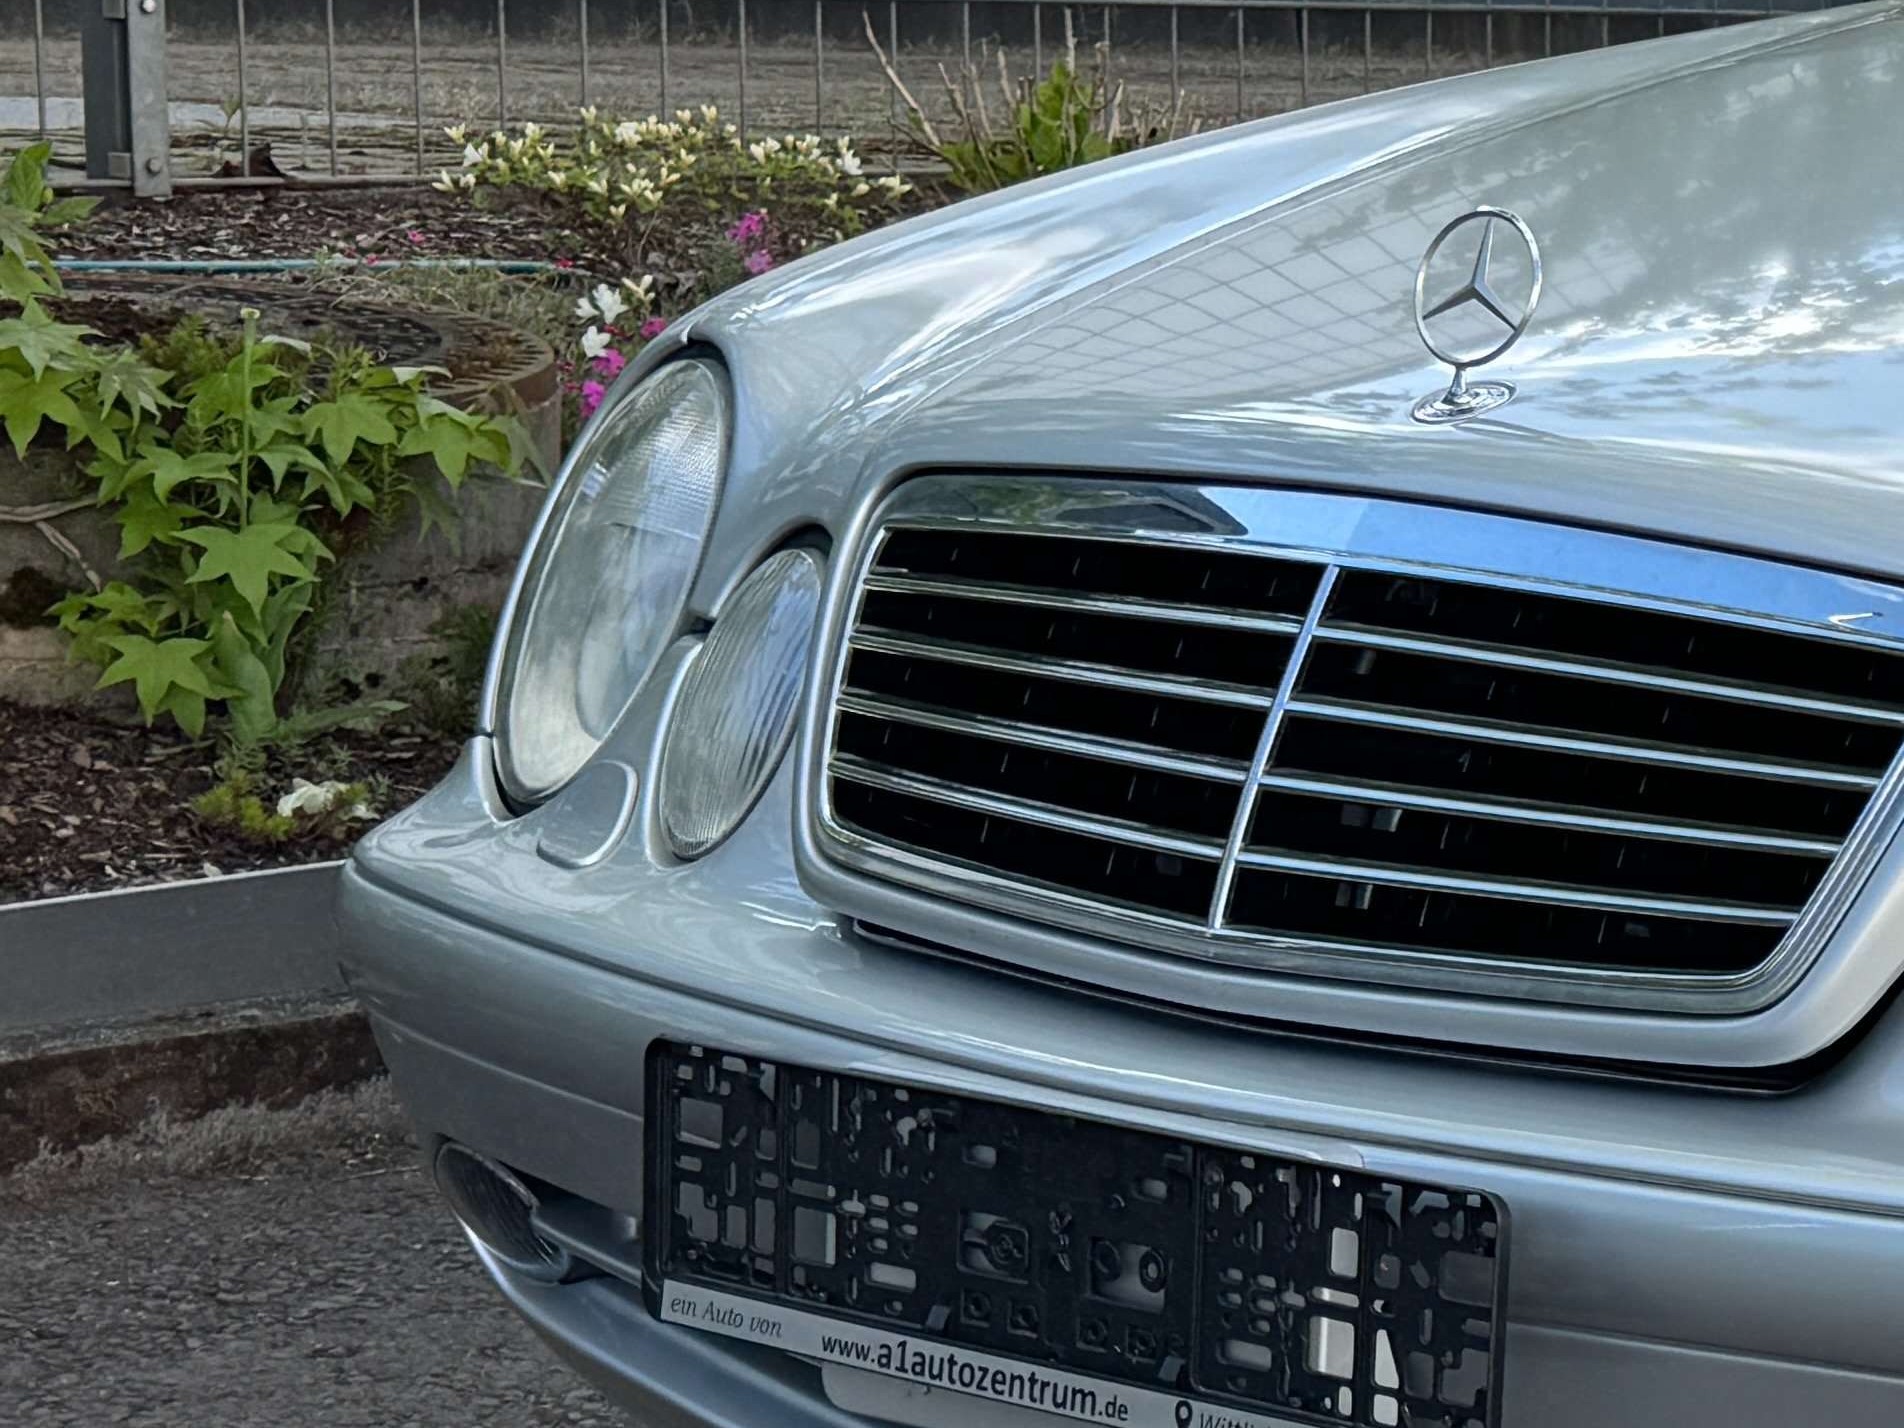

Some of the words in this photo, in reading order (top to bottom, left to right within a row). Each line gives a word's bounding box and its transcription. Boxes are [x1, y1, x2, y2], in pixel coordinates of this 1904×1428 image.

[670, 1298, 697, 1317] ein
[701, 1300, 744, 1329] Auto
[749, 1316, 783, 1339] von
[821, 1335, 1129, 1421] www.a1autozentrum.de
